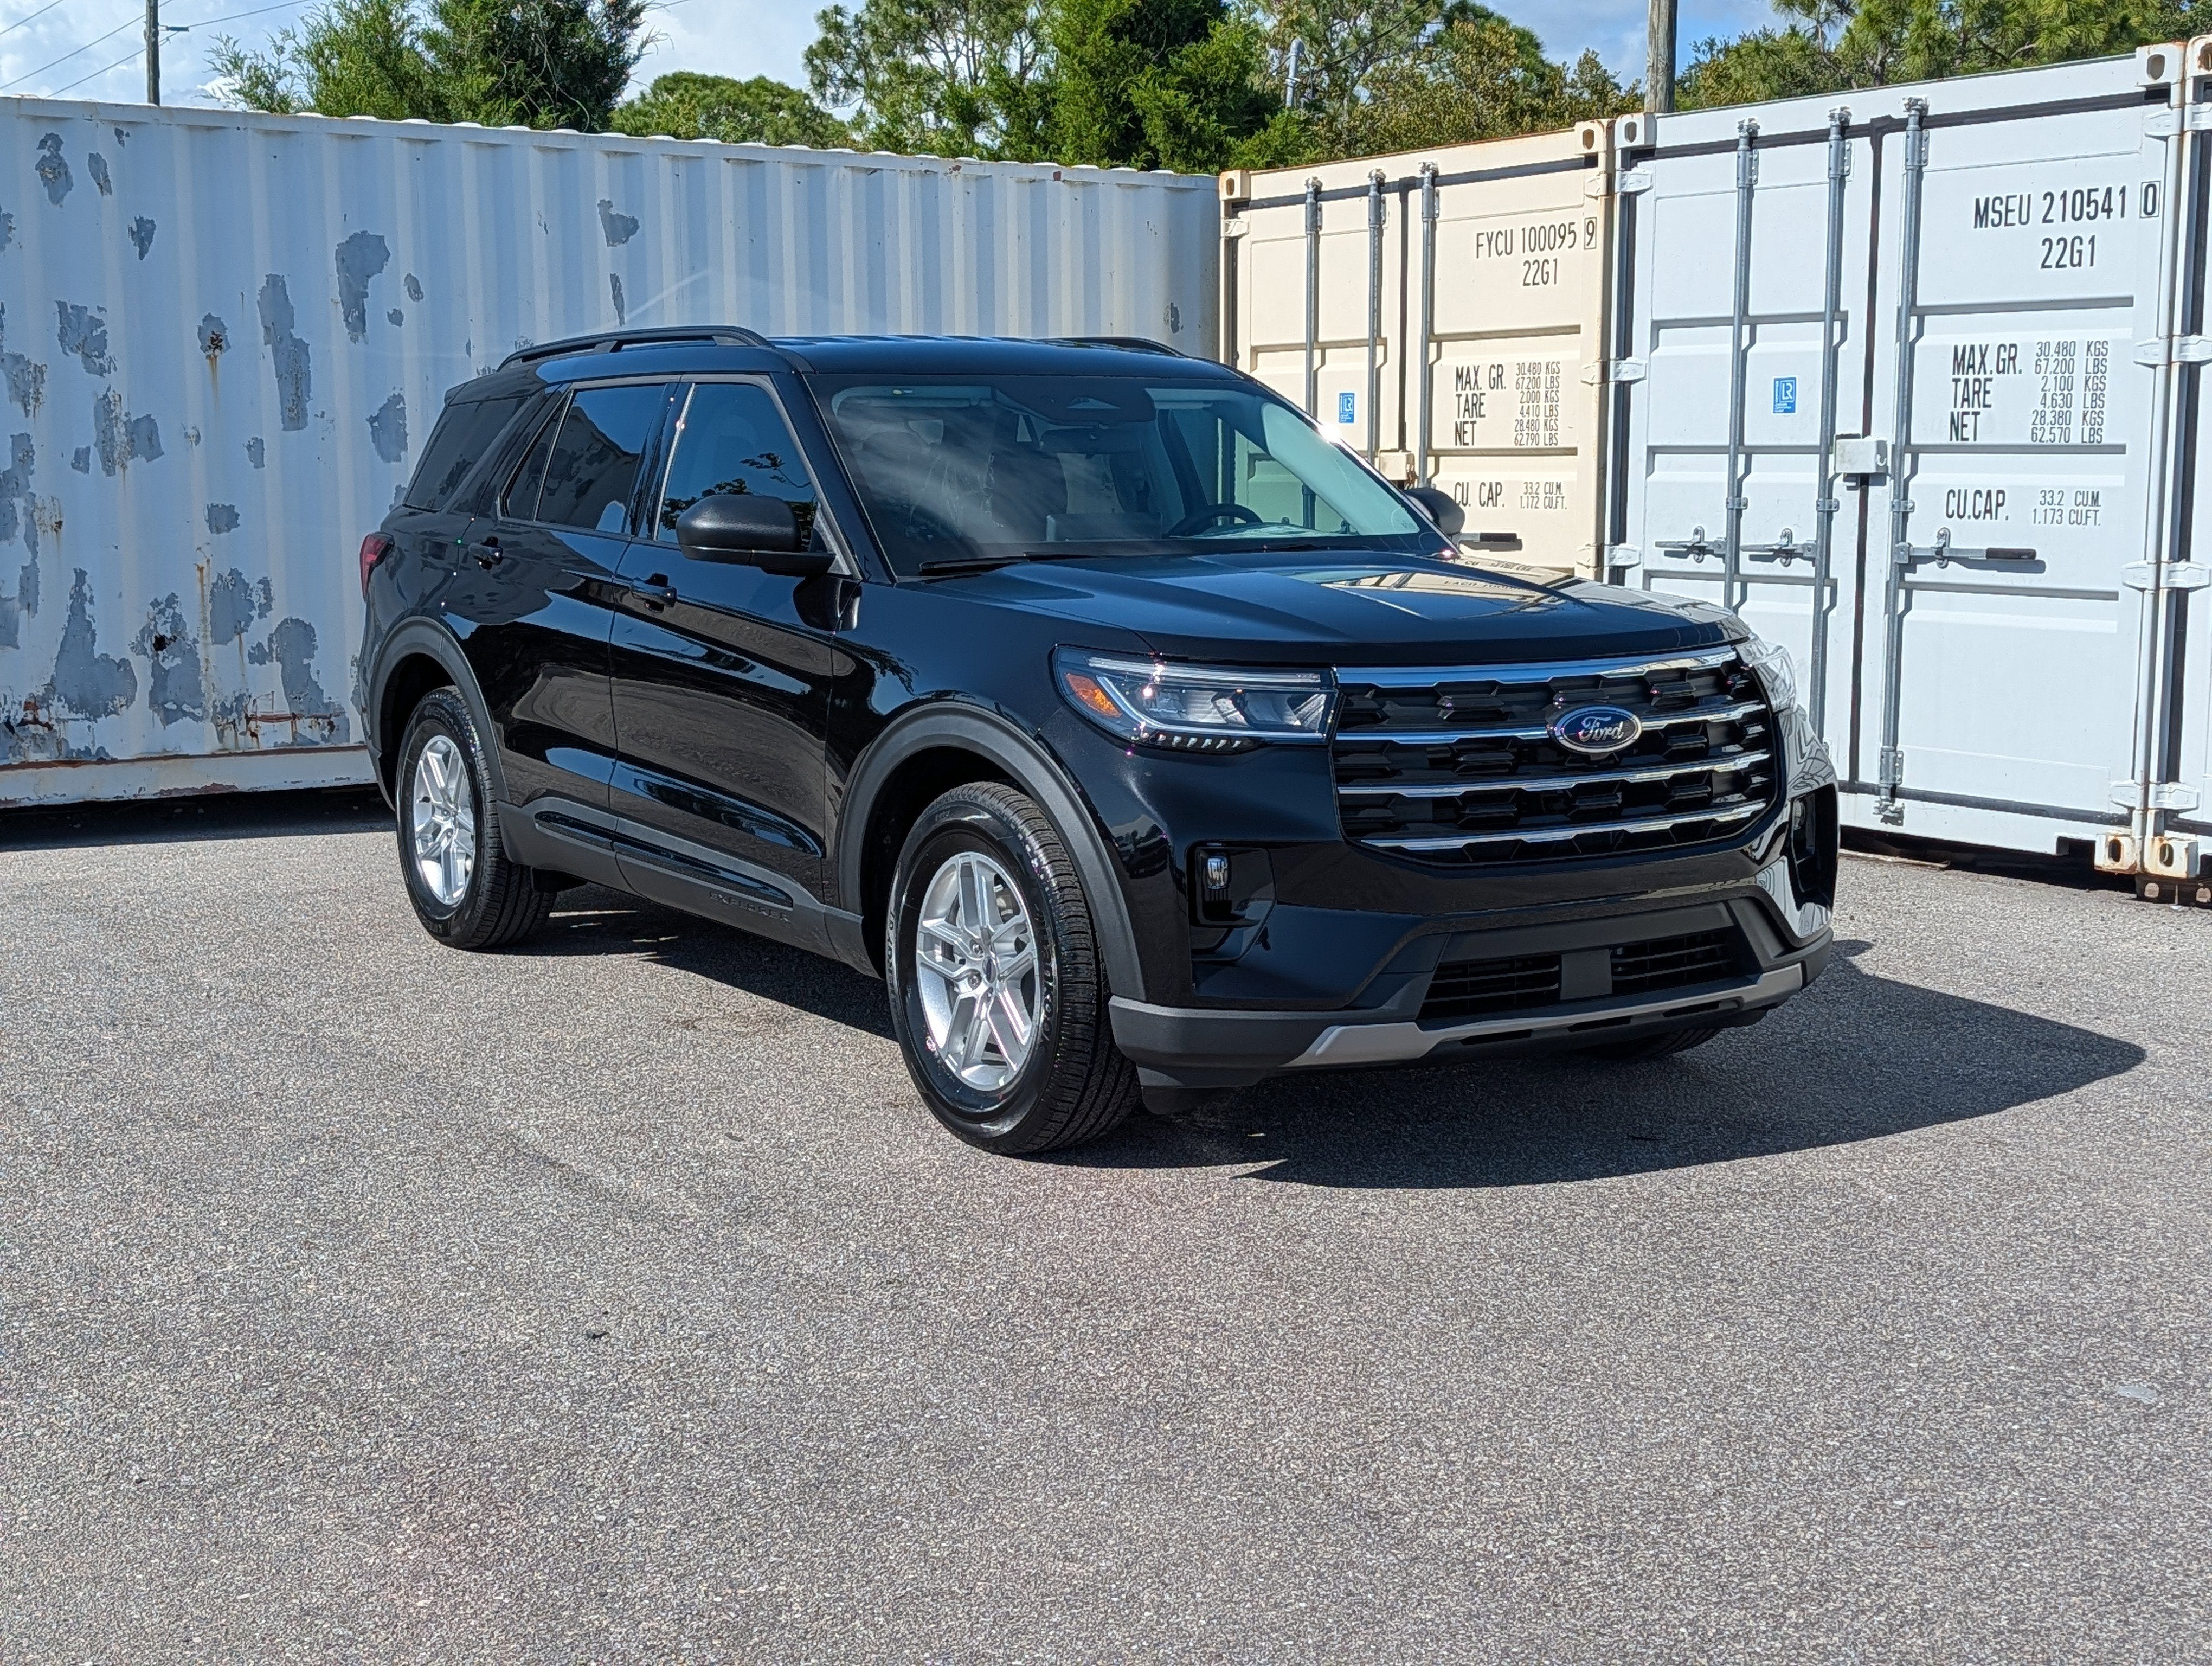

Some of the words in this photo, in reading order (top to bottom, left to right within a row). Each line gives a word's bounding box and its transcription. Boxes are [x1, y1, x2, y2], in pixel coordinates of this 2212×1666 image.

[1974, 194, 2031, 229] MSEU
[2042, 185, 2126, 223] 210541
[2143, 183, 2157, 215] 0
[1476, 229, 1513, 259] FYCU
[1522, 222, 1577, 253] 100095
[1586, 220, 1594, 246] 9
[2041, 235, 2095, 269] 22G1
[1523, 258, 1557, 286] 22G1
[2086, 341, 2108, 356] KGS
[1545, 361, 1560, 375] KGS
[2085, 358, 2107, 374] LBS
[1456, 366, 1482, 392] MAX.
[1489, 364, 1506, 390] GR.
[1545, 375, 1560, 389] LBS
[2084, 375, 2106, 392] KGS
[1545, 390, 1559, 403] KGS
[1952, 378, 1993, 408] TARE
[2083, 393, 2105, 409] LBS
[1456, 393, 1486, 418] TARE
[1544, 404, 1559, 418] LBS
[1544, 418, 1558, 432] KGS
[1950, 411, 1980, 441] NET
[2082, 410, 2104, 426] KGS
[1455, 420, 1477, 446] NET
[1544, 433, 1558, 446] LBS
[2081, 427, 2102, 444] LBS
[1455, 482, 1471, 507] CU.
[1479, 482, 1504, 507] CAP.
[2040, 490, 2064, 506] 33.2
[1578, 715, 1624, 741] Ford
